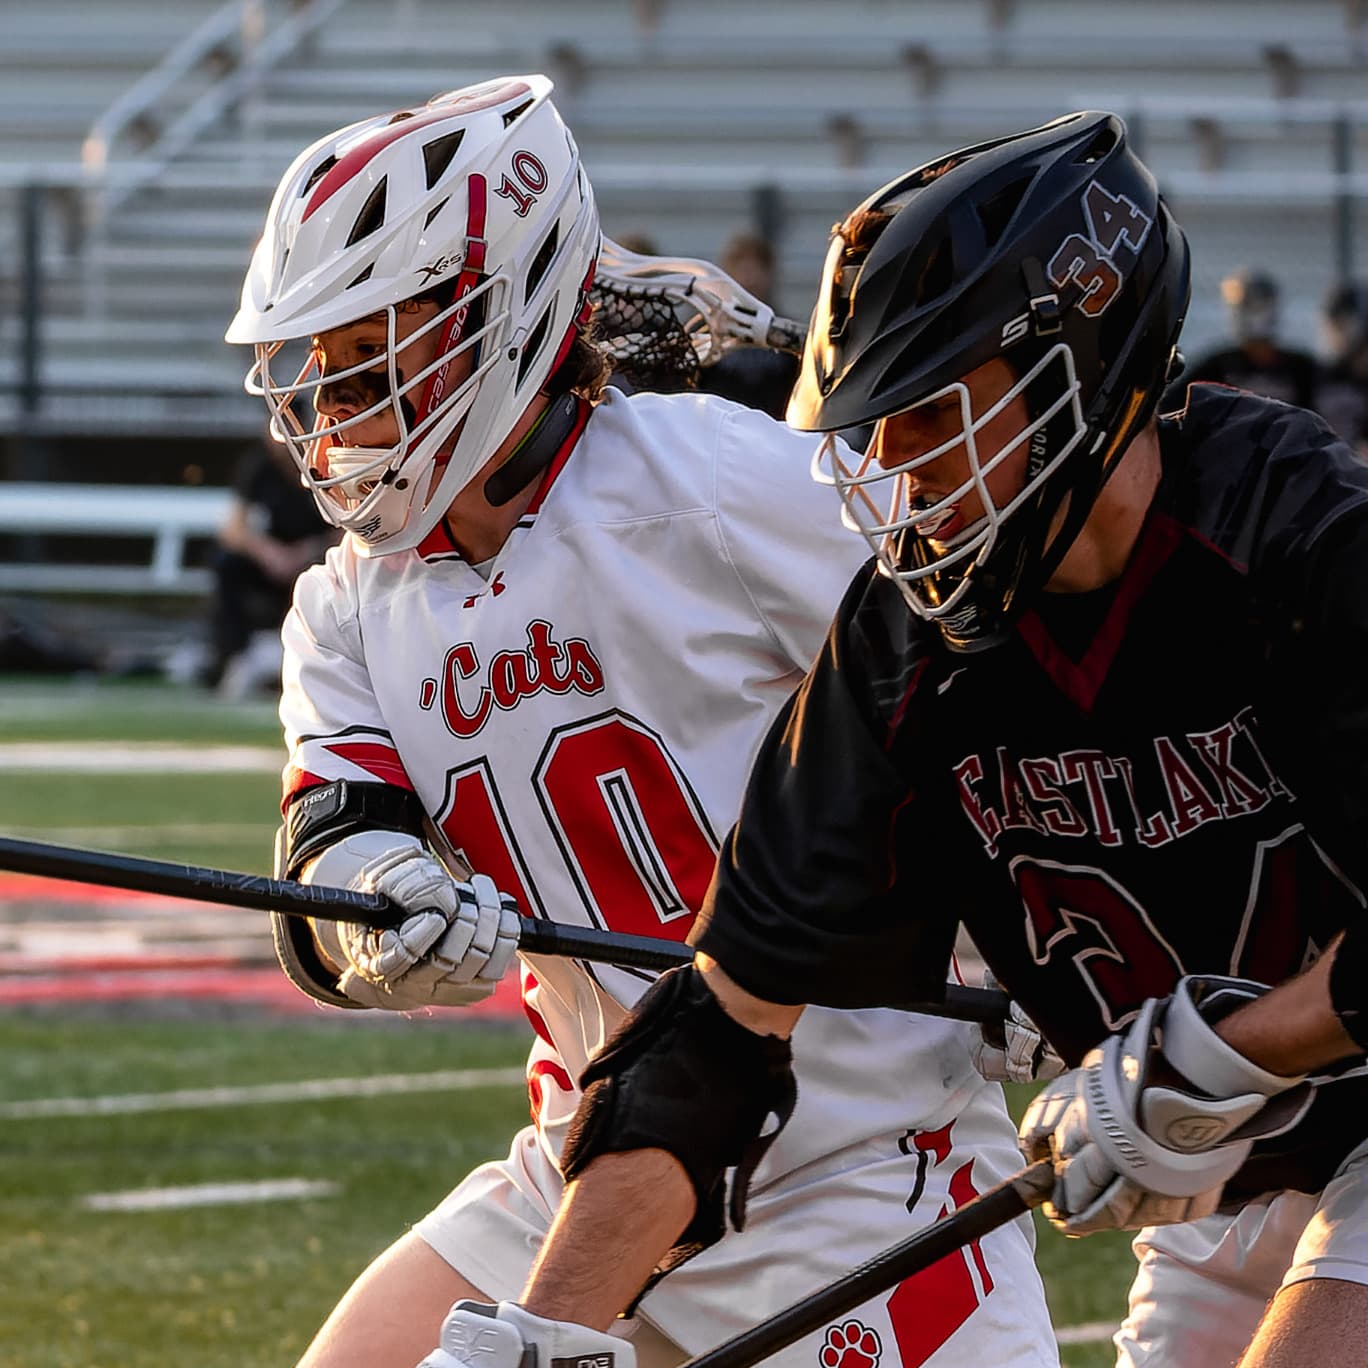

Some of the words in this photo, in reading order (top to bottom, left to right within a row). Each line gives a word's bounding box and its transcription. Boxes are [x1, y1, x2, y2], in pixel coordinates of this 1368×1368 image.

[494, 150, 548, 218] 10
[414, 254, 463, 287] XRS
[1046, 179, 1153, 319] 34
[419, 619, 605, 739] 'Cats
[431, 706, 724, 984] 10
